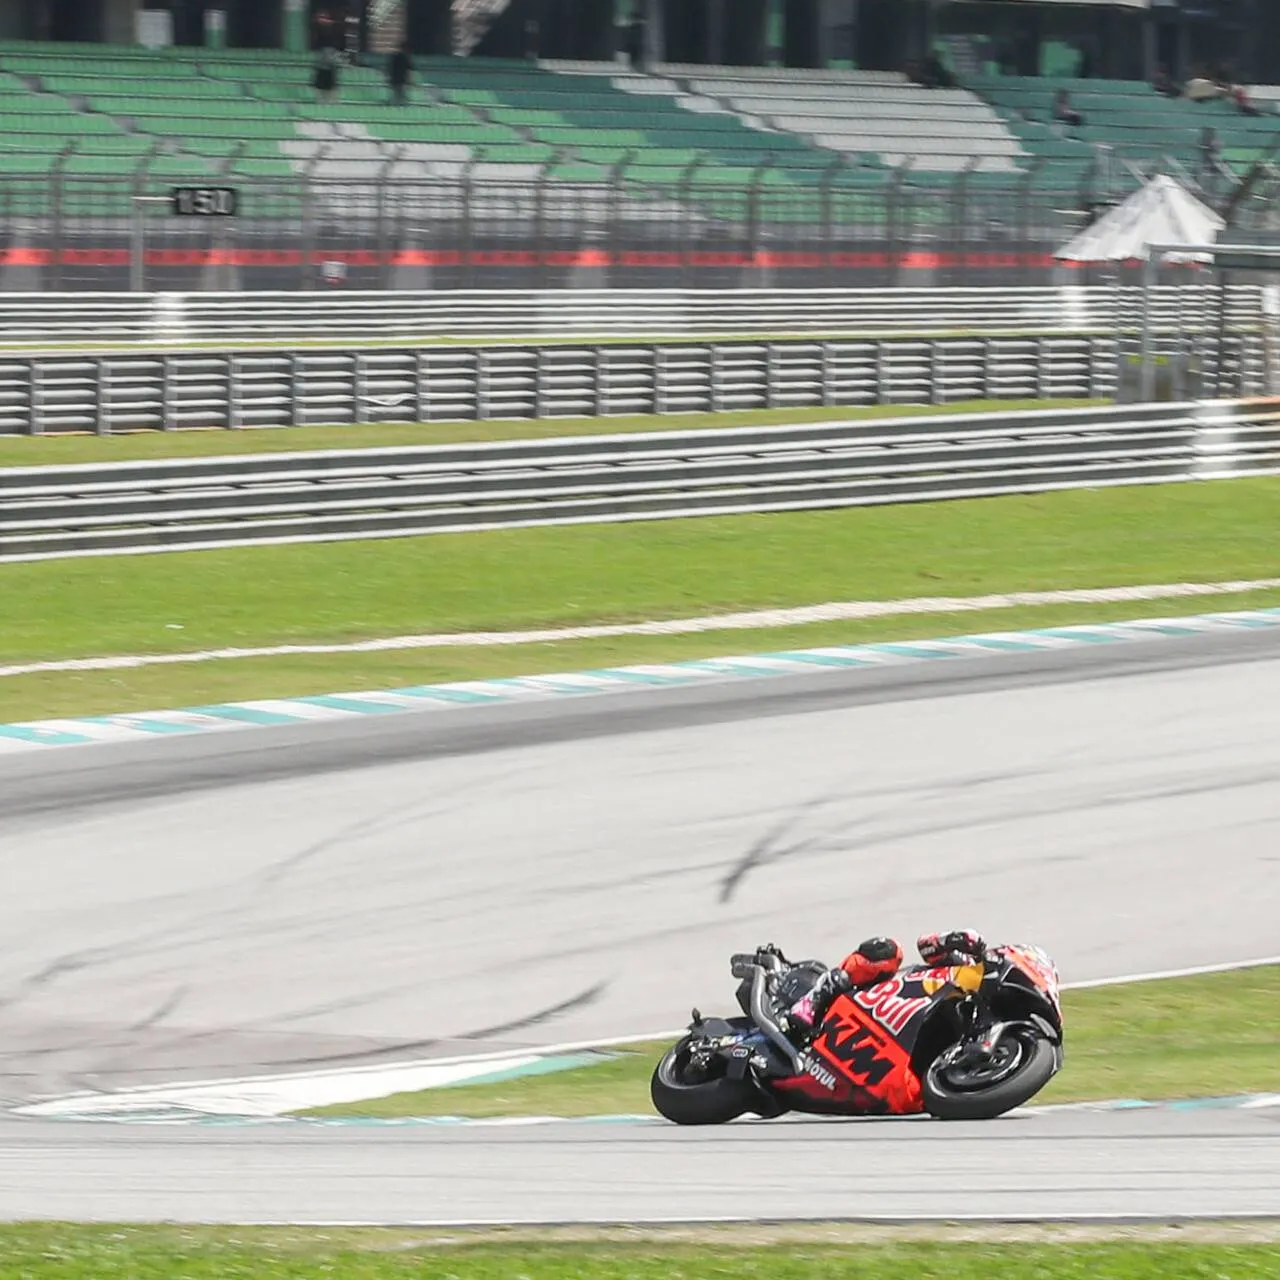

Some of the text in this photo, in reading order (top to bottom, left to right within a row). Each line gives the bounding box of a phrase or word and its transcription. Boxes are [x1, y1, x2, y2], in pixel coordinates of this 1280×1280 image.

[853, 976, 933, 1037] Bull
[802, 1057, 838, 1092] MOTUL
[822, 1012, 897, 1086] KTM
